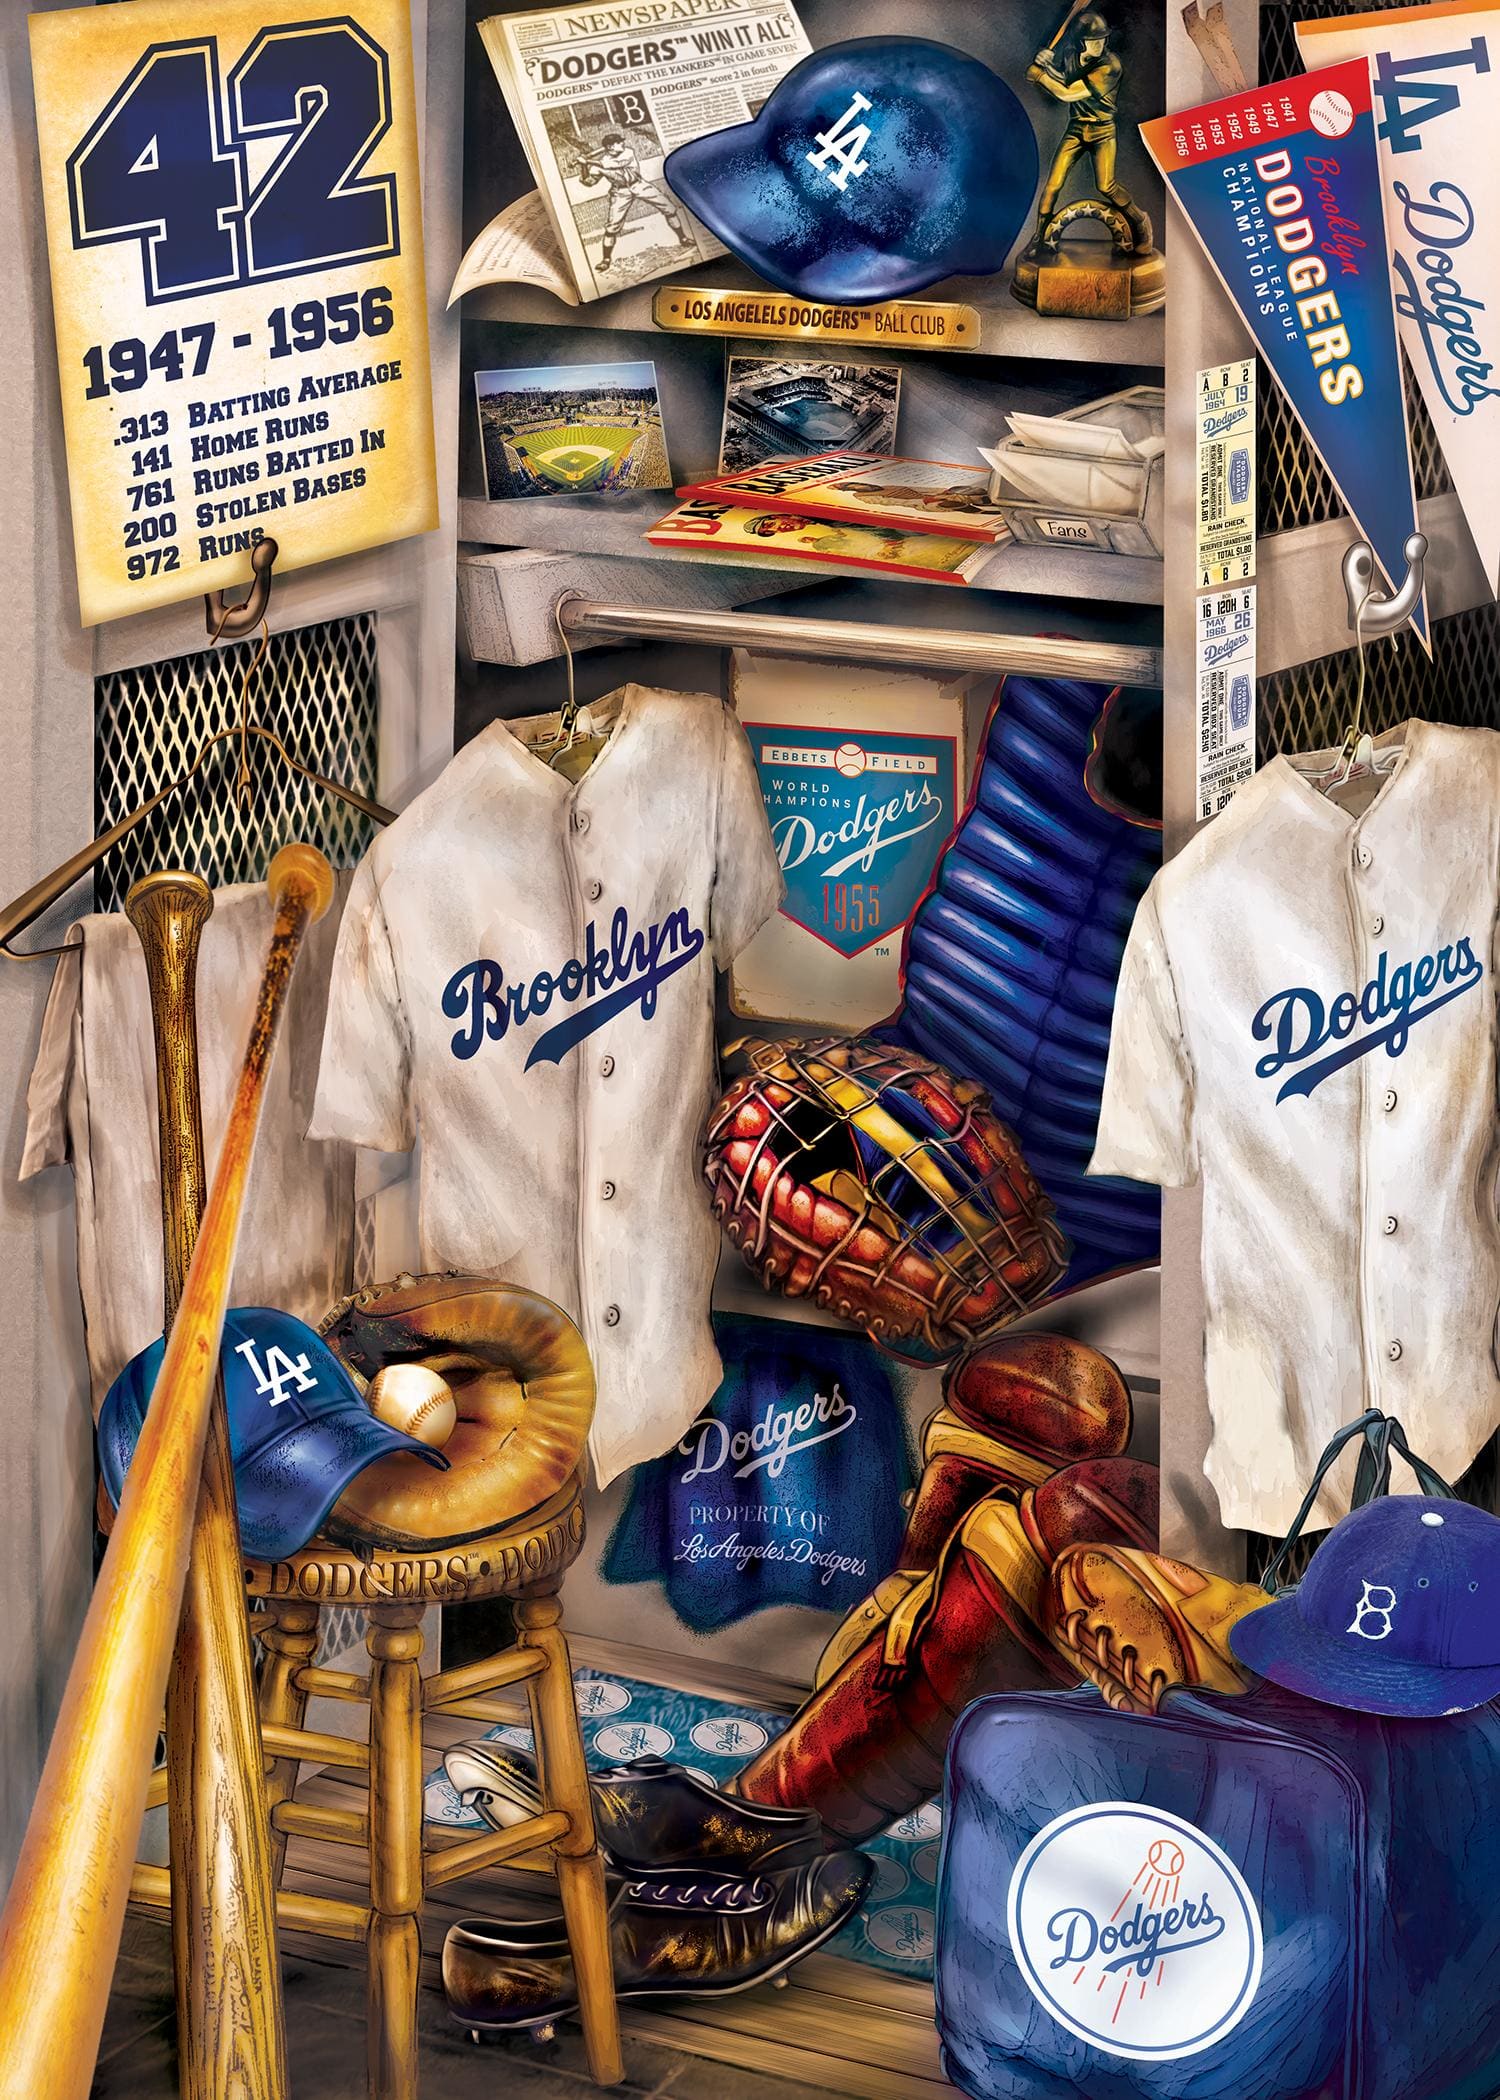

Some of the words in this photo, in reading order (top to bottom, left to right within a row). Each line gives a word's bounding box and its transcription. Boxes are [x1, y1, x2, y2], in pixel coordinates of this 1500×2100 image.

[692, 28, 735, 54] WIN
[734, 25, 753, 47] IT
[757, 18, 790, 43] ALL
[601, 74, 642, 89] DEFEAT
[644, 67, 667, 80] THE
[722, 55, 735, 65] IN
[735, 49, 766, 62] GAME
[768, 43, 798, 57] SEVEN
[709, 73, 733, 84] score
[734, 71, 740, 80] 2
[741, 69, 751, 78] in
[751, 63, 778, 76] fourth
[1278, 96, 1297, 124] 1941
[1373, 36, 1490, 154] LA
[1225, 112, 1243, 140] 1952
[1243, 106, 1261, 135] 1949
[1261, 101, 1279, 129] 1947
[805, 91, 873, 192] LA
[1172, 129, 1190, 157] 1956
[1189, 123, 1208, 151] 1955
[1207, 117, 1225, 146] 1953
[66, 15, 401, 306] 42
[1304, 156, 1367, 276] Brooklyn
[1222, 167, 1275, 316] CHAMPIONS
[1238, 163, 1271, 255] NATIONAL
[1267, 264, 1298, 341] LEAGUE
[1253, 148, 1364, 406] DODGERS
[1392, 180, 1500, 417] Dodgers
[684, 300, 713, 320] LOS
[713, 301, 787, 326] ANGELELS
[874, 312, 907, 333] BALL
[910, 314, 945, 335] CLUB
[82, 322, 216, 400] 1947
[267, 286, 394, 360] 1956
[1203, 378, 1210, 392] A
[1223, 373, 1229, 387] B
[1243, 368, 1249, 382] 2
[1204, 390, 1226, 402] JULY
[1235, 385, 1248, 403] 19
[113, 410, 169, 447] .313
[188, 382, 291, 429] BATTING
[299, 360, 403, 407] AVERAGE
[1205, 399, 1225, 410] 1964
[1203, 407, 1248, 438] Dodgers
[131, 445, 172, 477] 141
[191, 430, 260, 463] HOME
[265, 410, 330, 446] RUNS
[126, 478, 175, 512] 761
[193, 460, 261, 497] RUNS
[266, 441, 354, 480] BATTED
[361, 428, 385, 453] IN
[721, 456, 885, 495] BASEBALL
[1201, 471, 1209, 498] TOTAL
[122, 512, 178, 549] 200
[196, 487, 287, 530] STOLEN
[292, 466, 367, 505] BASES
[1047, 521, 1088, 539] Fans
[1208, 523, 1223, 532] RAIN
[1224, 518, 1245, 528] CHECK
[126, 546, 180, 582] 972
[199, 527, 265, 563] RUNS
[1200, 541, 1222, 552] RESERVED
[1217, 549, 1235, 560] TOTAL
[1203, 571, 1209, 586] A
[1223, 567, 1229, 581] B
[1243, 562, 1249, 576] 2
[1203, 603, 1211, 618] 16
[1217, 597, 1237, 615] 120H
[1244, 595, 1250, 609] 6
[1206, 617, 1226, 629] MAY
[1234, 611, 1251, 630] 26
[1206, 626, 1227, 638] 1966
[1204, 634, 1249, 666] Dodgers
[1201, 699, 1209, 728] TOTAL
[772, 749, 828, 764] EBBETS
[872, 755, 927, 771] FIELD
[1208, 751, 1223, 762] RAIN
[1225, 742, 1246, 755] CHECK
[772, 780, 830, 794] WORLD
[1218, 775, 1235, 788] TOTAL
[763, 794, 852, 809] HAMPIONS
[1203, 801, 1211, 817] 16
[1217, 790, 1236, 811] 120
[770, 779, 943, 877] Dodgers
[822, 882, 880, 932] 1955
[441, 905, 704, 1073] Brooklyn
[1251, 936, 1483, 1106] Dodgers
[235, 1338, 320, 1408] LA
[678, 1384, 857, 1484] Dodgers
[689, 1504, 796, 1527] PROPERTY
[800, 1509, 831, 1536] OF
[673, 1533, 709, 1563] Los
[708, 1532, 785, 1571] Angeles
[784, 1538, 867, 1585] Dodgers
[1346, 1579, 1397, 1640] B
[1046, 1891, 1226, 1978] Dodgers
